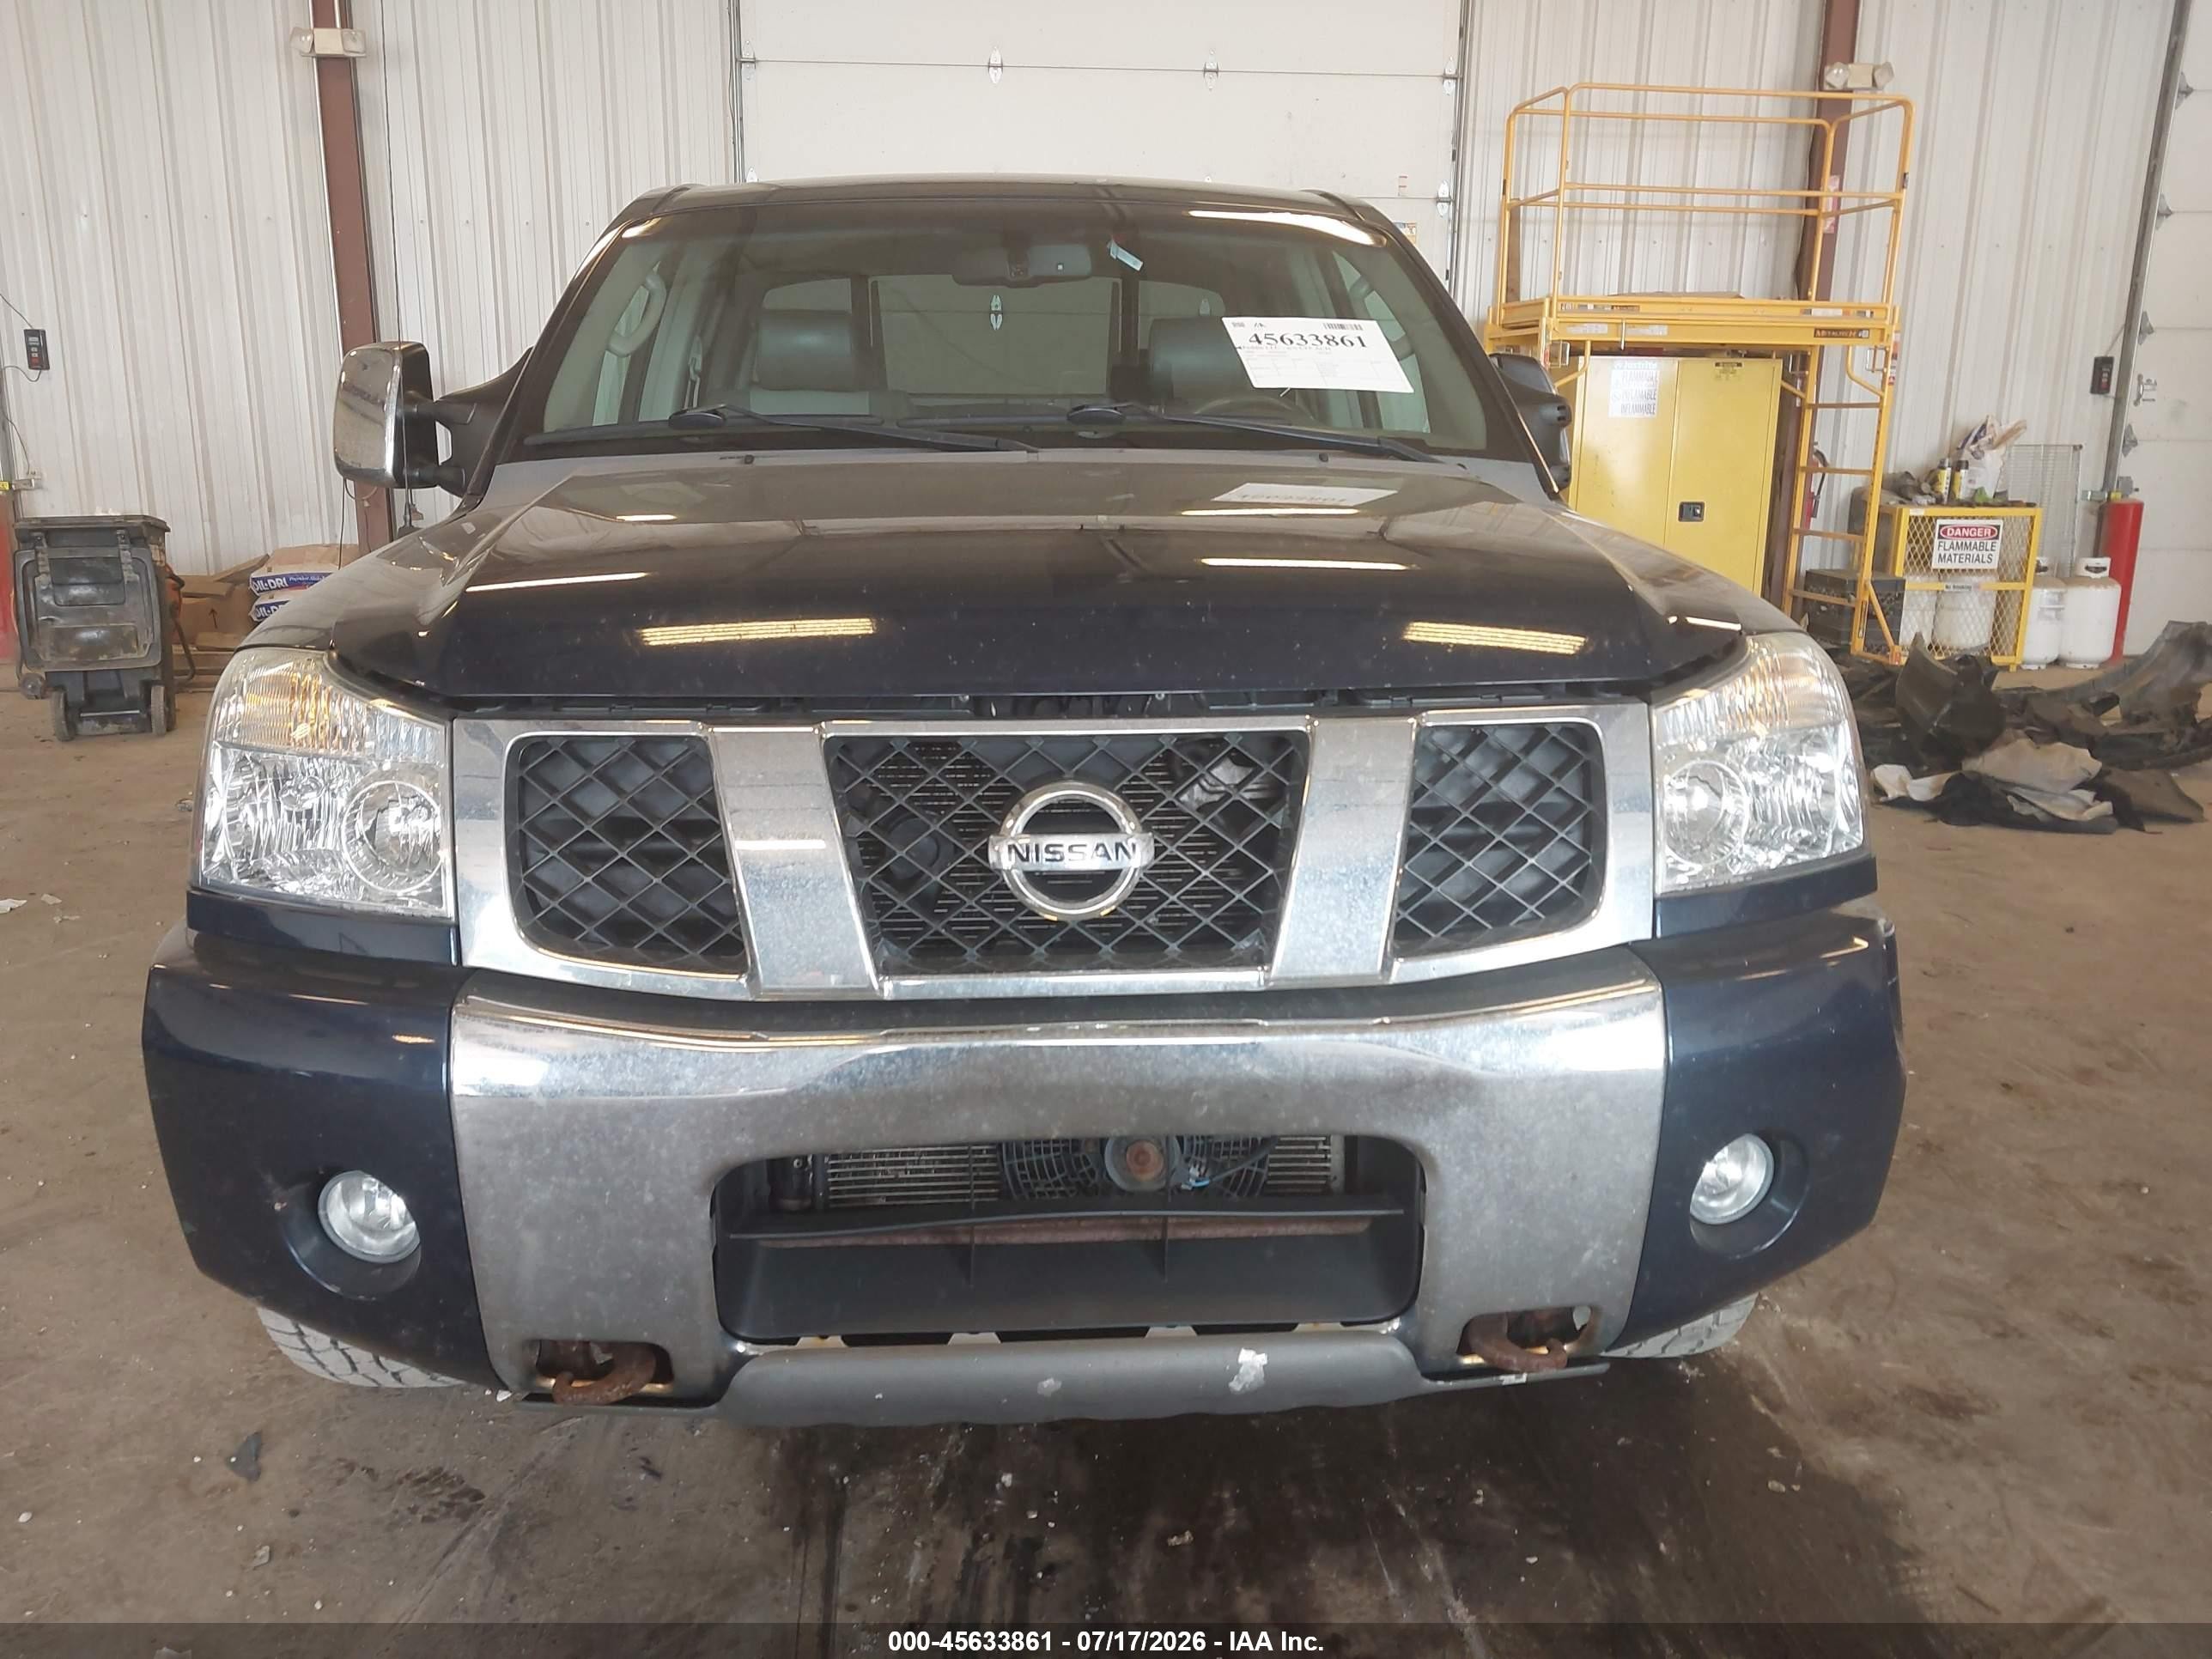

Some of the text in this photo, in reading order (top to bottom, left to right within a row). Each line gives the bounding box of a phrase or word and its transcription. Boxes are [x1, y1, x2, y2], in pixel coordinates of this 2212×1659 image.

[1249, 333, 1367, 348] 45633861
[1947, 527, 1992, 538] DANGER
[1938, 541, 1997, 551] FLAMMABLE
[1938, 553, 1994, 564] MATERIALS
[1007, 842, 1136, 863] NISSAN
